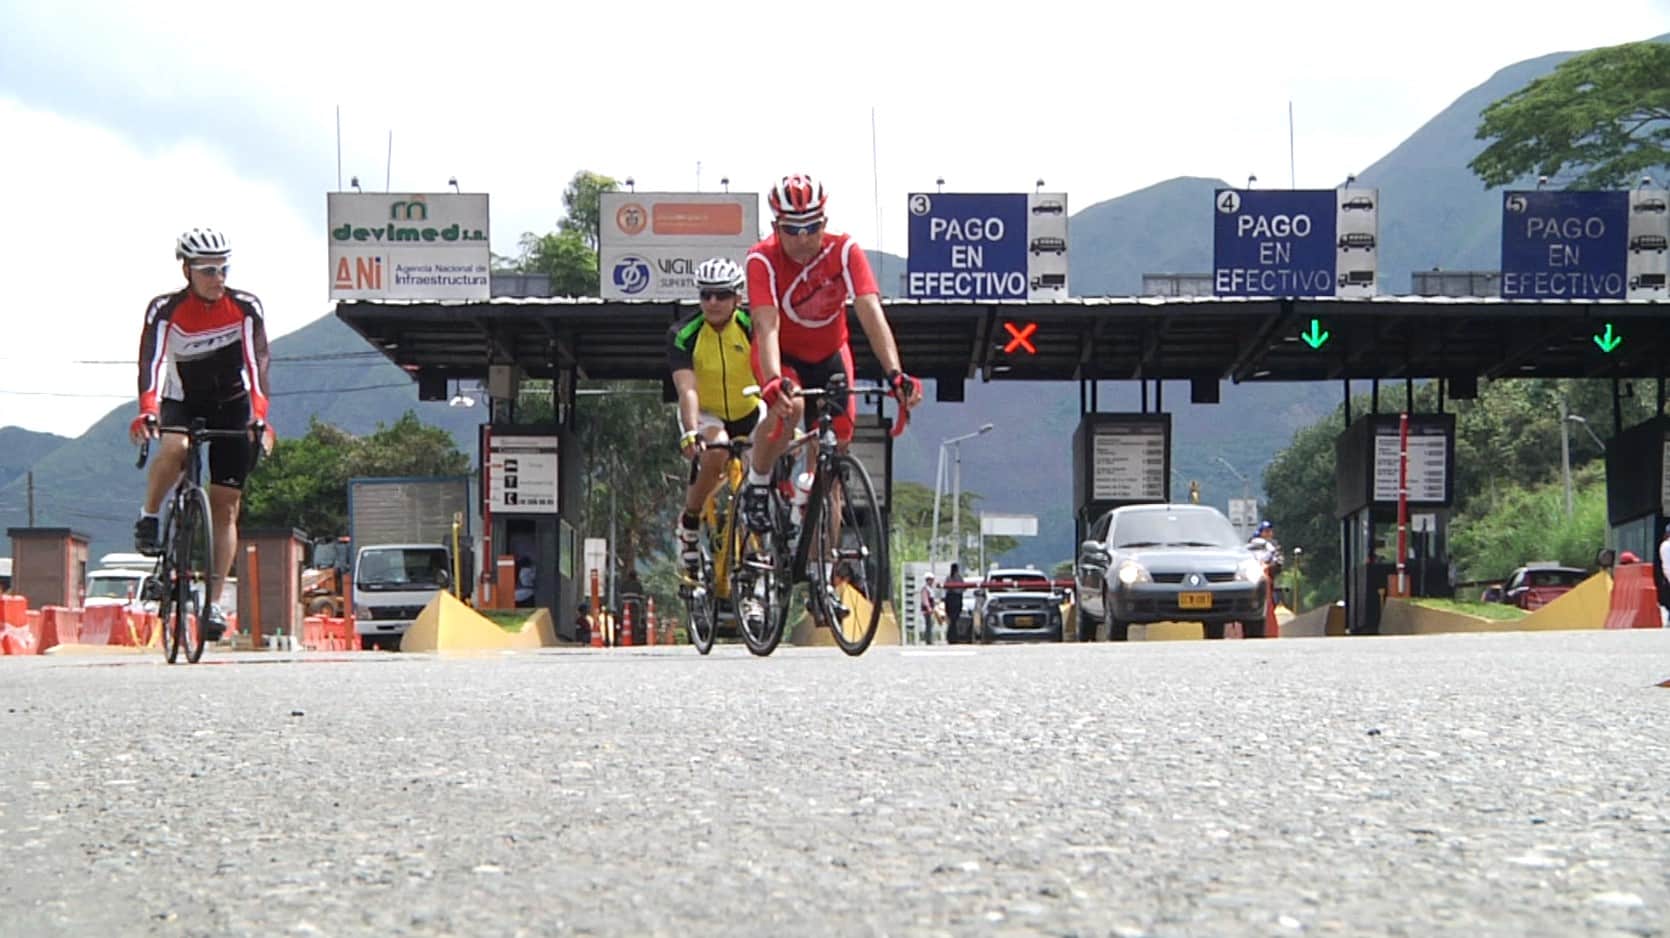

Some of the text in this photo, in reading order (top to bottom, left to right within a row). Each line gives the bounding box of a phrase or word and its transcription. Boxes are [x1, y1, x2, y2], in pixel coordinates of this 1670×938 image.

[914, 195, 927, 215] 3
[1221, 192, 1235, 212] 4
[332, 223, 460, 242] devimed
[930, 217, 1004, 241] PAGO
[1237, 214, 1311, 238] PAGO
[1526, 216, 1606, 239] PAGO
[951, 245, 983, 269] EN
[1260, 241, 1291, 265] EN
[1549, 243, 1580, 267] EN
[395, 264, 487, 275] Agencia Nacional de
[395, 274, 488, 286] Infraestructura
[1215, 268, 1331, 292] EFECTIVO
[909, 271, 1026, 295] EFECTIVO
[1503, 272, 1623, 295] EFECTIVO
